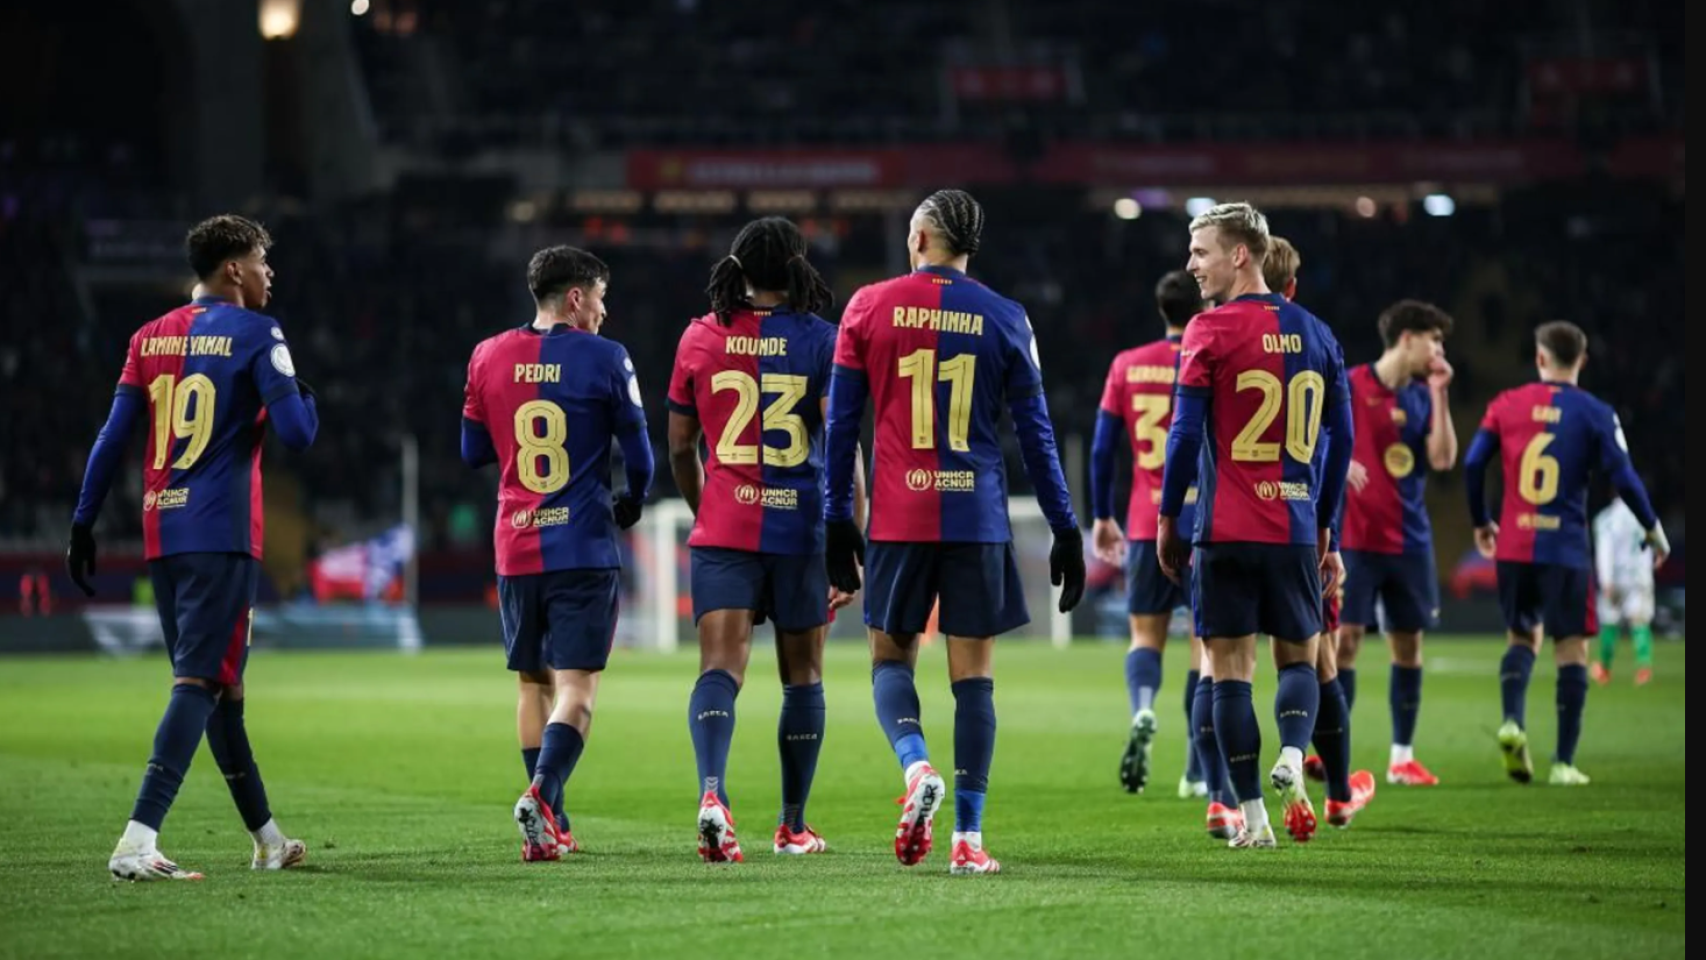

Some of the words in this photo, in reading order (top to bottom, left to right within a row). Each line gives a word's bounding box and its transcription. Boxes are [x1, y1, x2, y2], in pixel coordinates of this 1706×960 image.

[893, 306, 983, 335] RAPHINHA
[141, 336, 188, 357] LAMINE
[190, 336, 232, 356] YAMAL
[725, 336, 787, 356] KOUNDE
[1263, 334, 1301, 353] OLMO
[514, 364, 561, 383] PEDRI
[898, 349, 976, 452] 11
[148, 373, 216, 470] 19
[711, 370, 809, 468] 23
[1231, 369, 1325, 464] 20
[1132, 394, 1170, 470] 3
[514, 400, 570, 494] 8
[934, 471, 974, 479] UNHCR
[1519, 432, 1559, 505] 6
[761, 489, 797, 498] UNHCR
[934, 479, 974, 488] ACNUR
[760, 496, 797, 506] ACNUR
